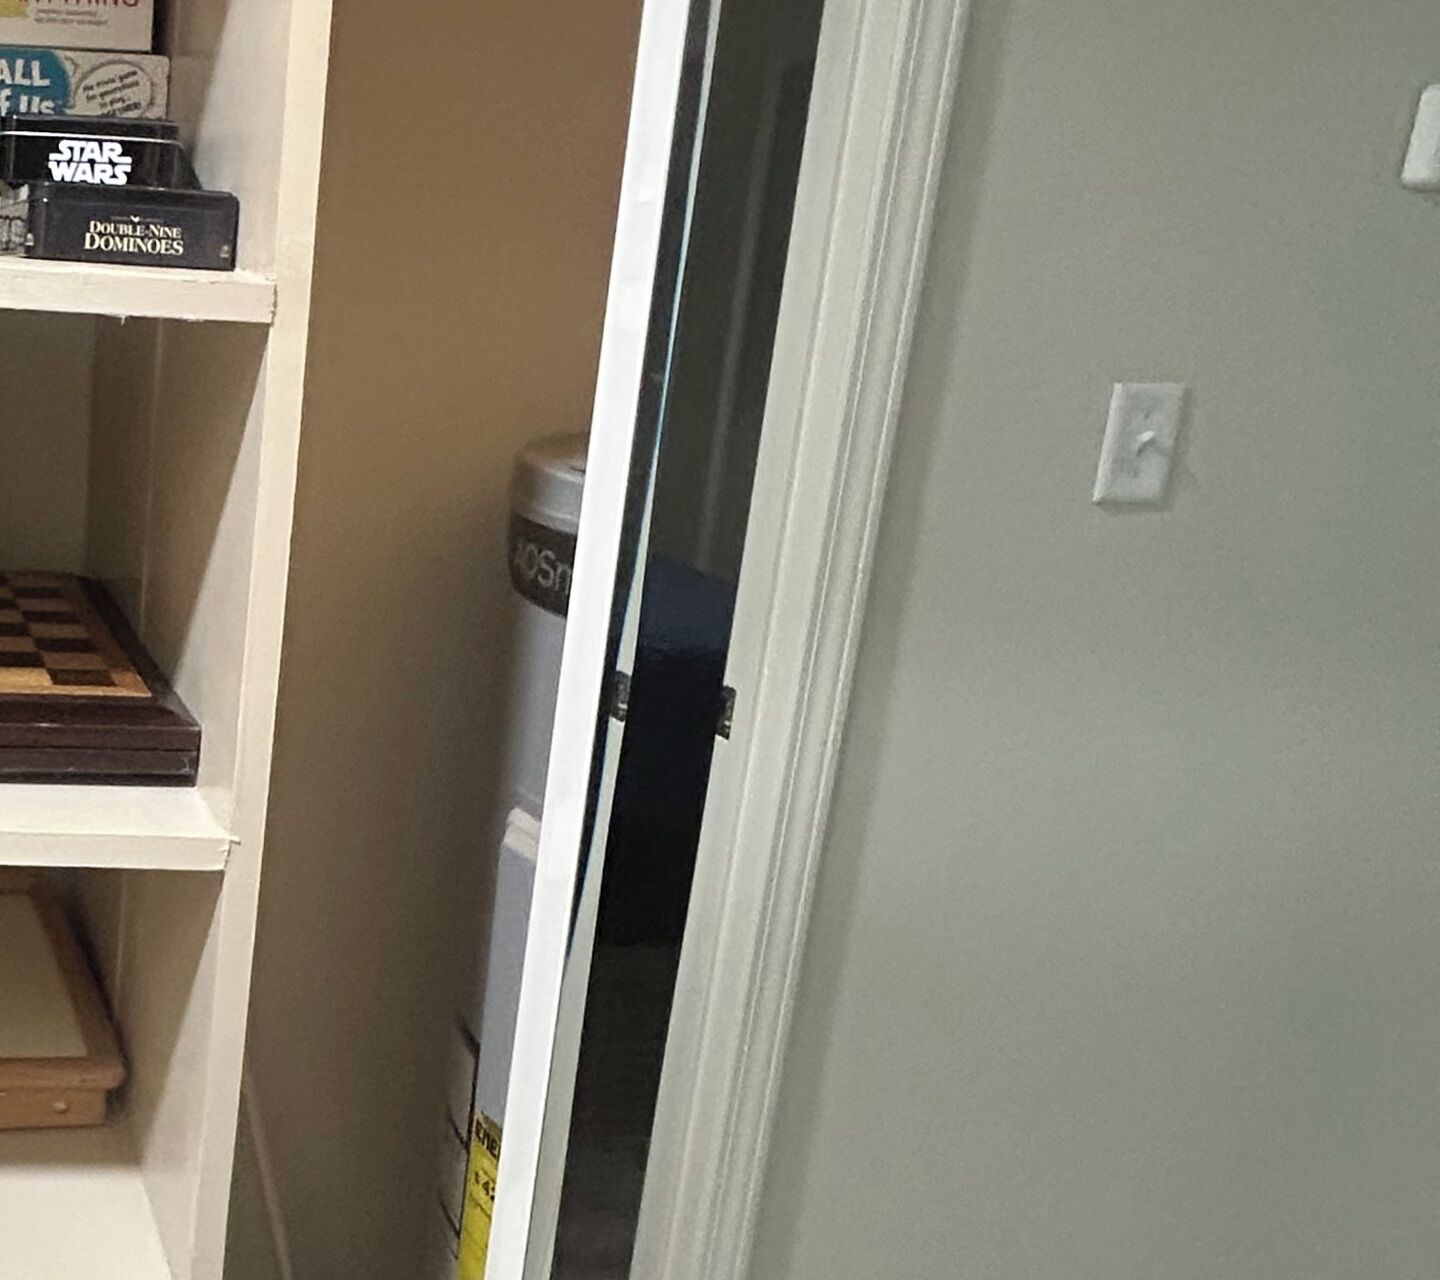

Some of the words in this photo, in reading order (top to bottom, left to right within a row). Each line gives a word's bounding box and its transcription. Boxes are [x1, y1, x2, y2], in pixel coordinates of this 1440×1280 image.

[49, 139, 132, 164] STAR
[48, 162, 132, 186] WARS
[88, 220, 183, 239] DOUBLE-NINE
[83, 232, 185, 256] DOMINOES
